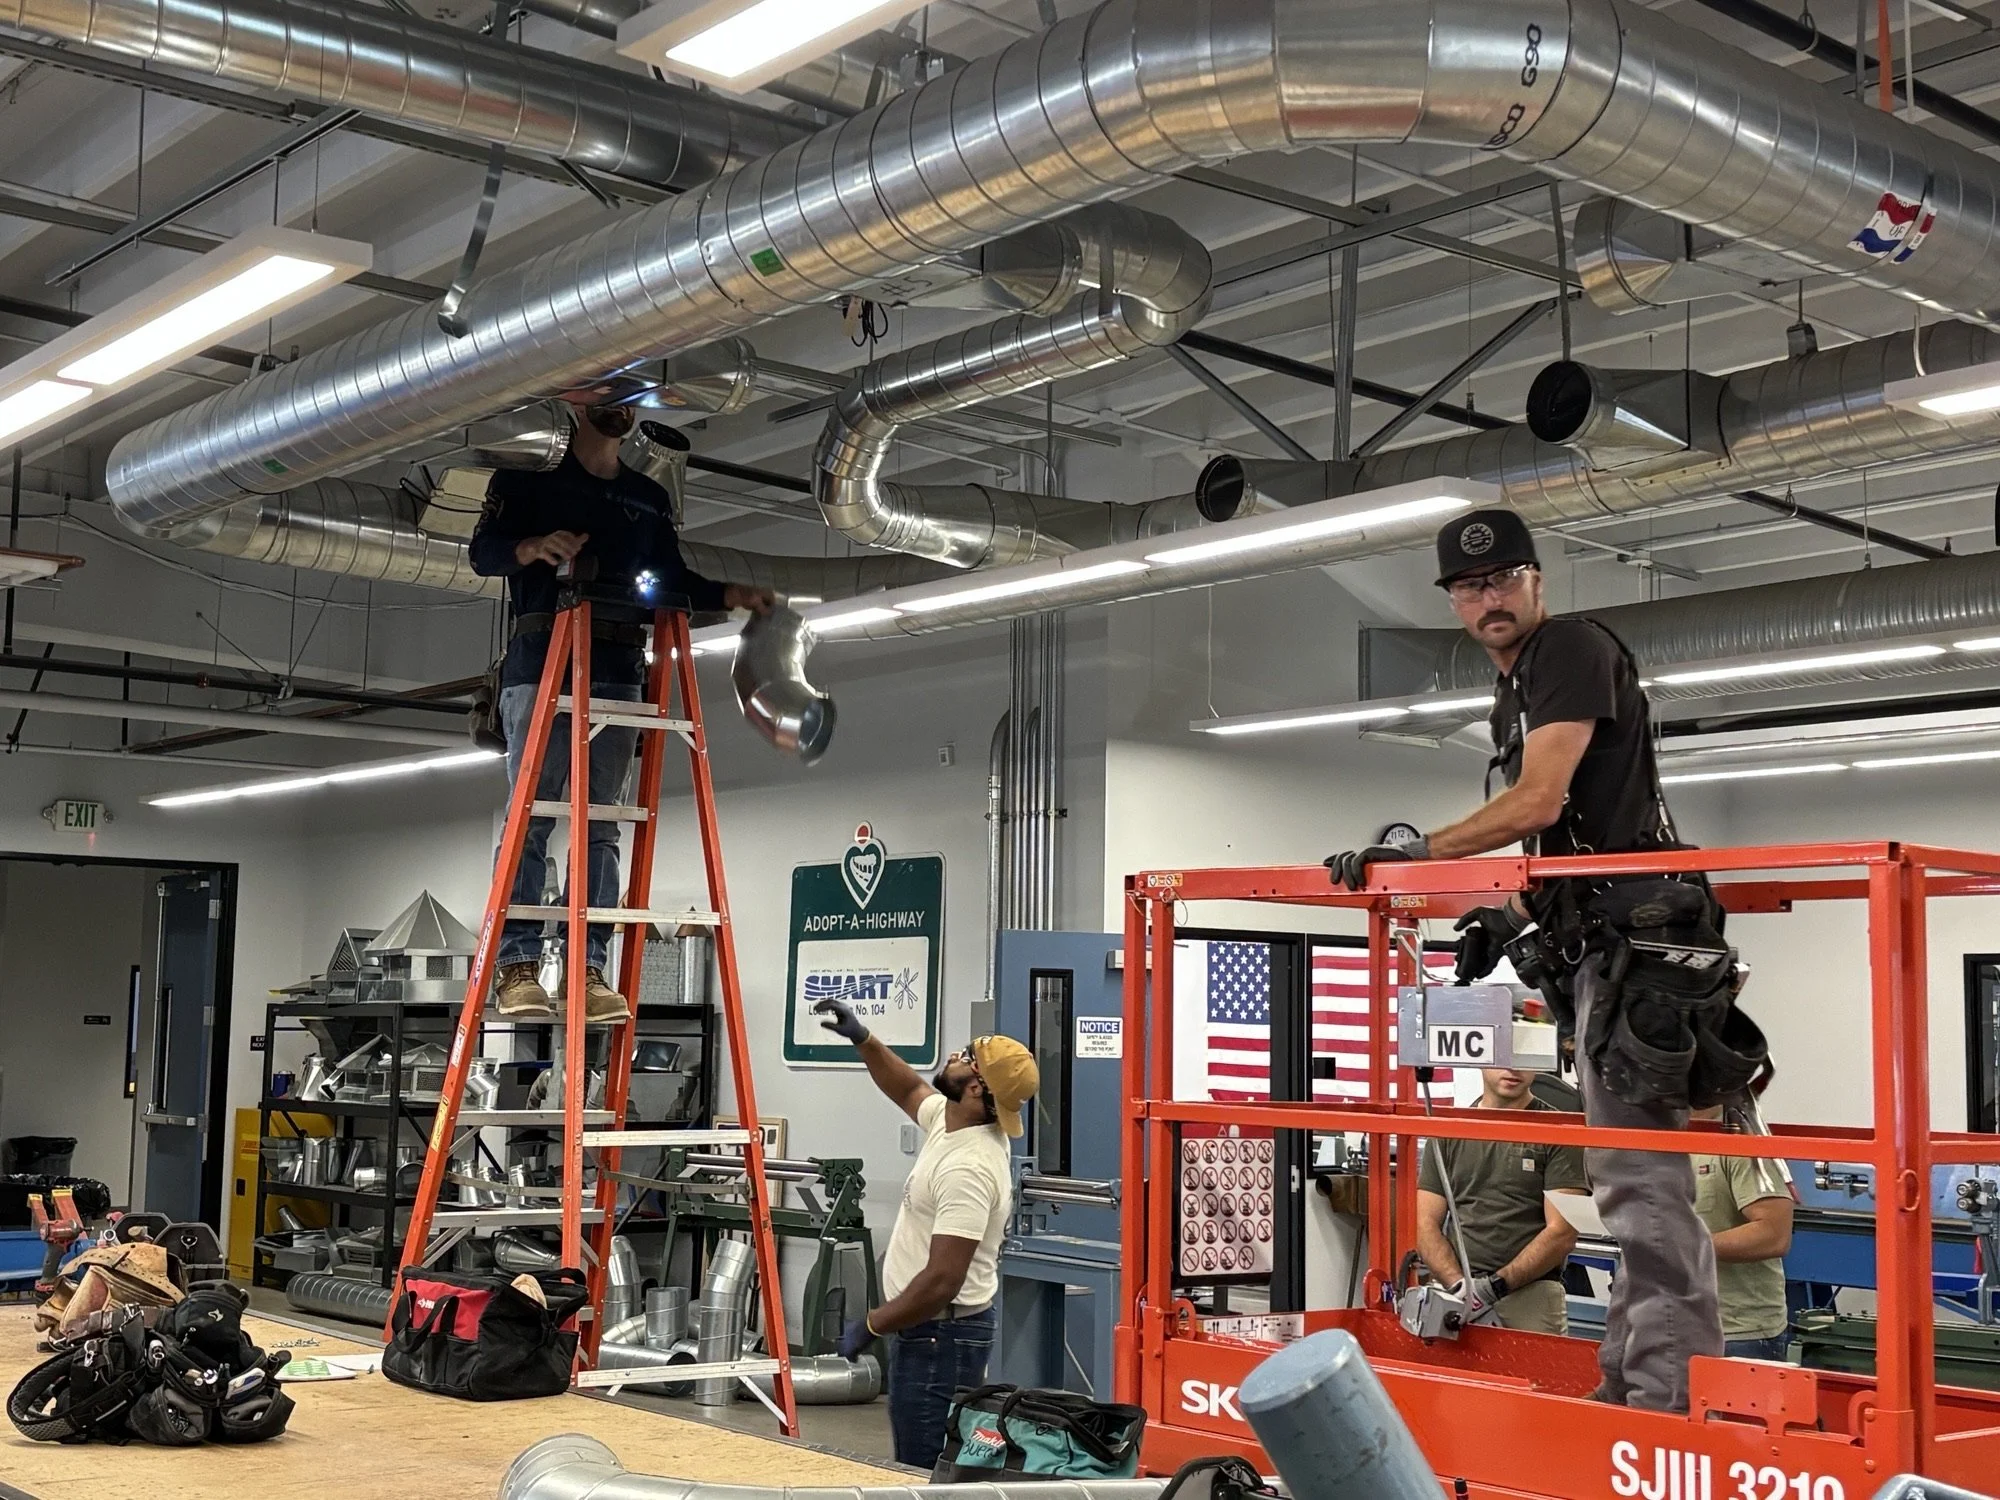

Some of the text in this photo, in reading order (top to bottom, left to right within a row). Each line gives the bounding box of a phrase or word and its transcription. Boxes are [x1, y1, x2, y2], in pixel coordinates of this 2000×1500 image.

[64, 802, 98, 828] EXIT
[804, 911, 925, 932] ADOPT-A-HIGHWAY
[804, 974, 893, 1001] SMART
[855, 1004, 869, 1016] No.
[871, 1004, 885, 1016] 104
[1081, 1021, 1118, 1033] NOTICE
[1437, 1030, 1484, 1057] MC
[1181, 1379, 1246, 1422] SK
